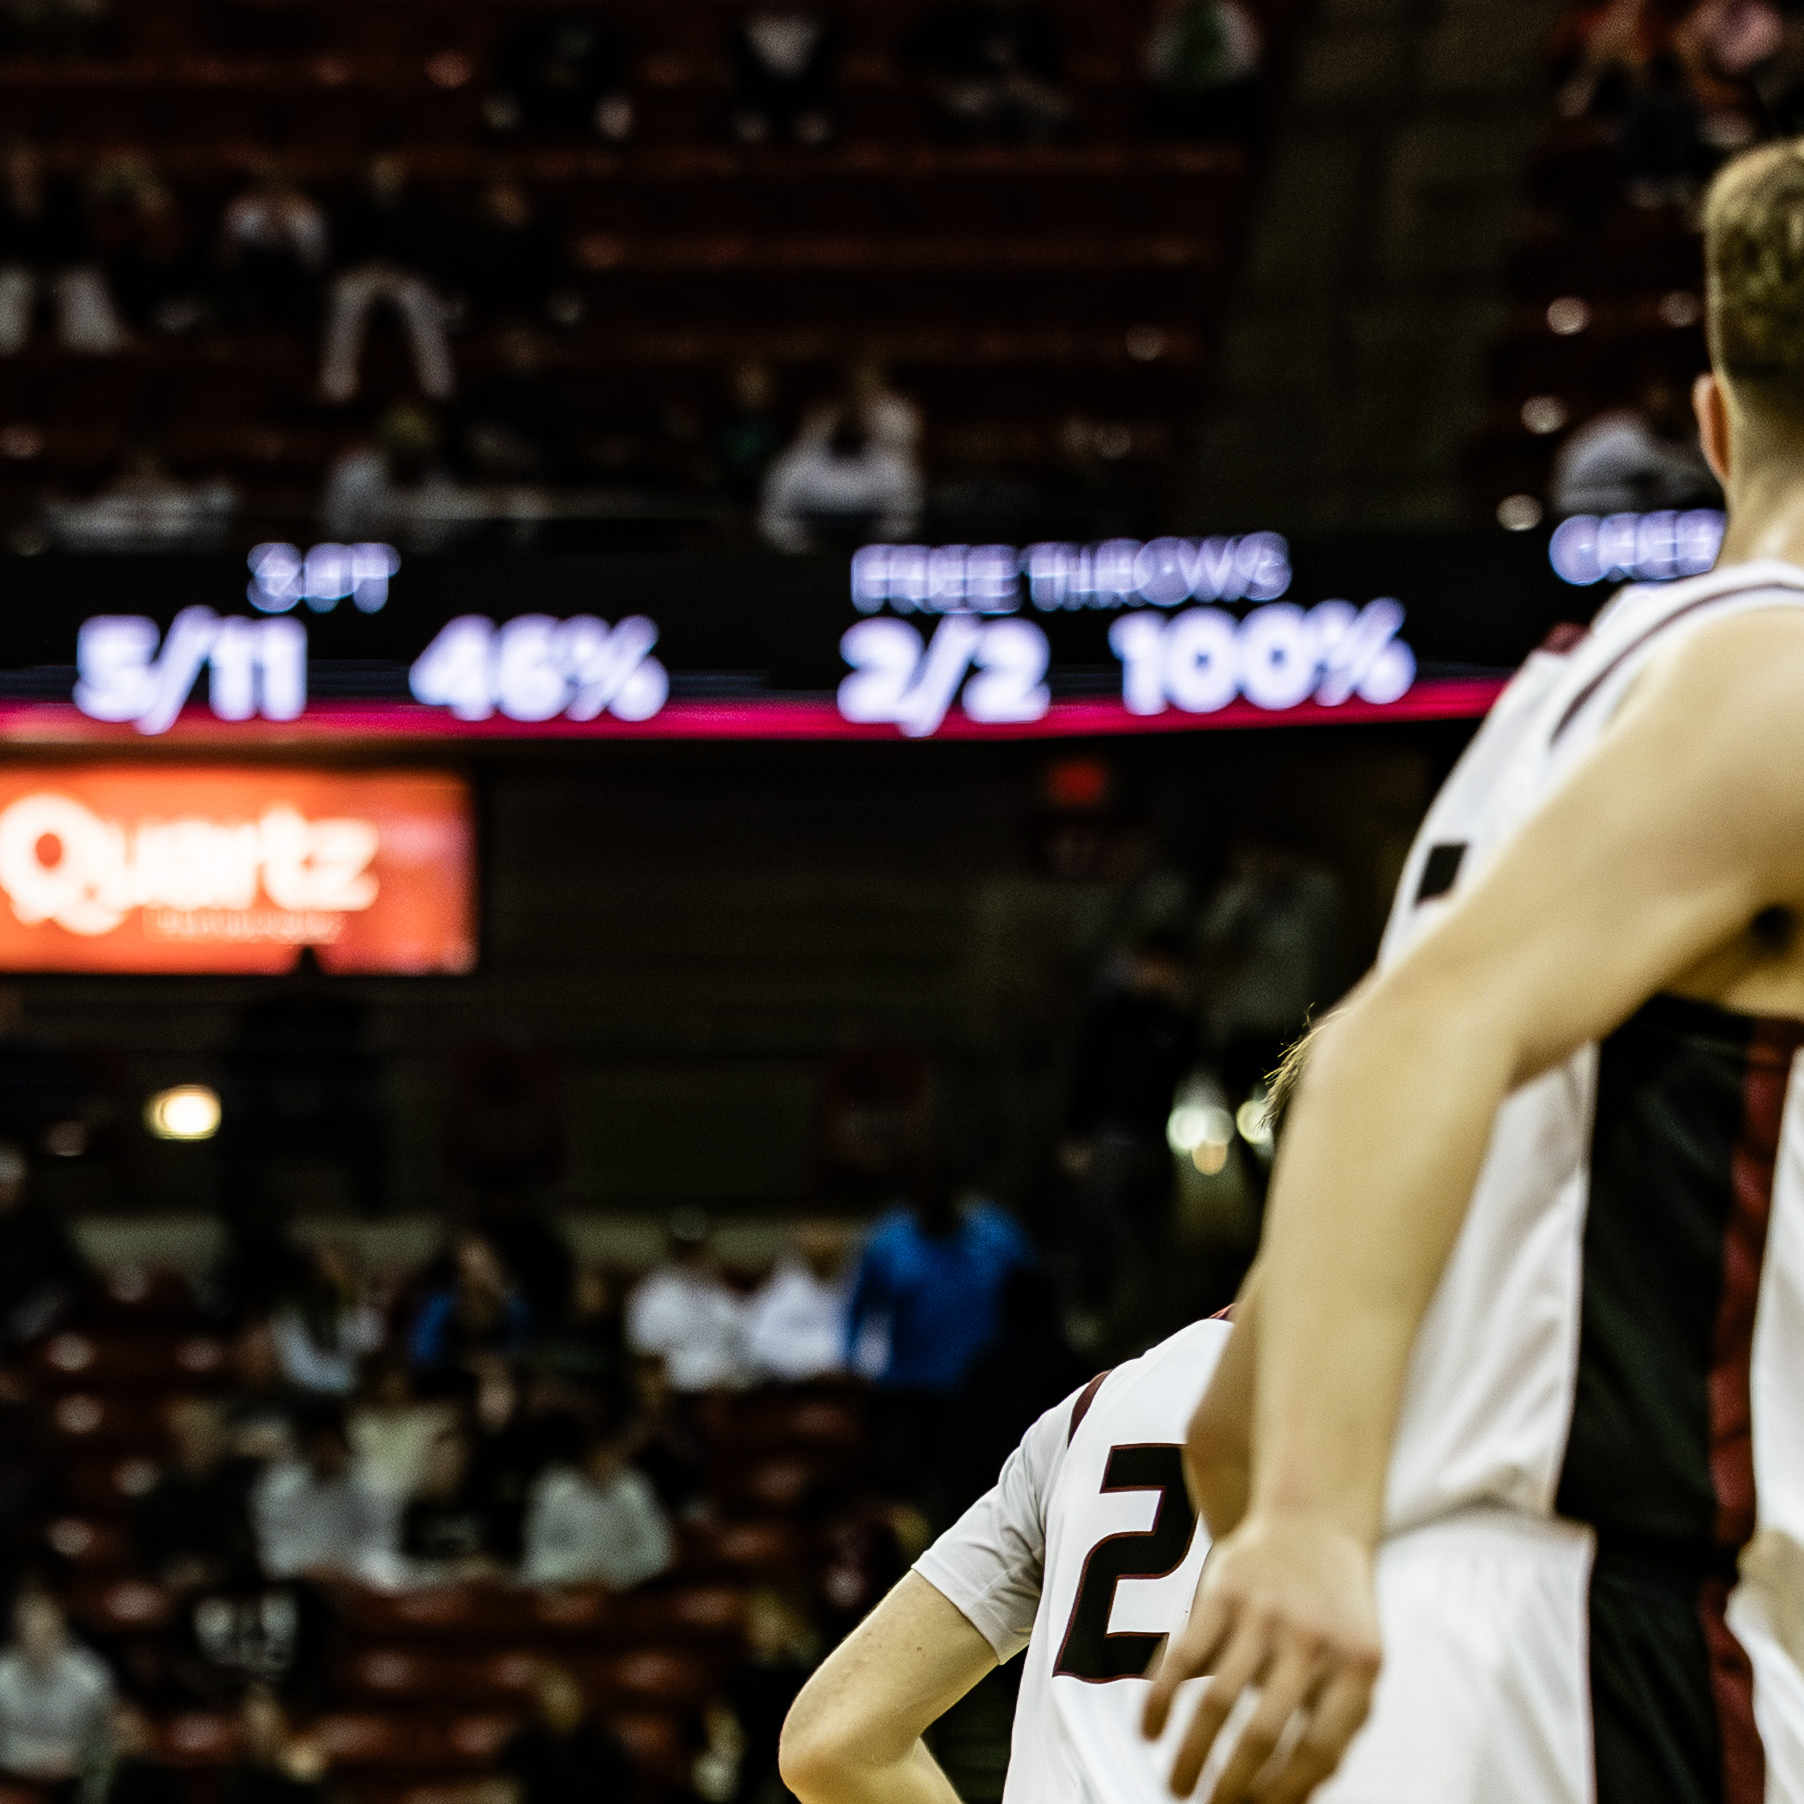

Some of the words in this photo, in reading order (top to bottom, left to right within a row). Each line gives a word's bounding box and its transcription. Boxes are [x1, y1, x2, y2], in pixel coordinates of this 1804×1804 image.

[851, 543, 1023, 614] FREE
[1019, 531, 1291, 612] THROWS
[73, 605, 307, 735] 5/11
[409, 613, 669, 723] 46%
[837, 613, 1051, 737] 2/2
[1108, 597, 1416, 716] 100%
